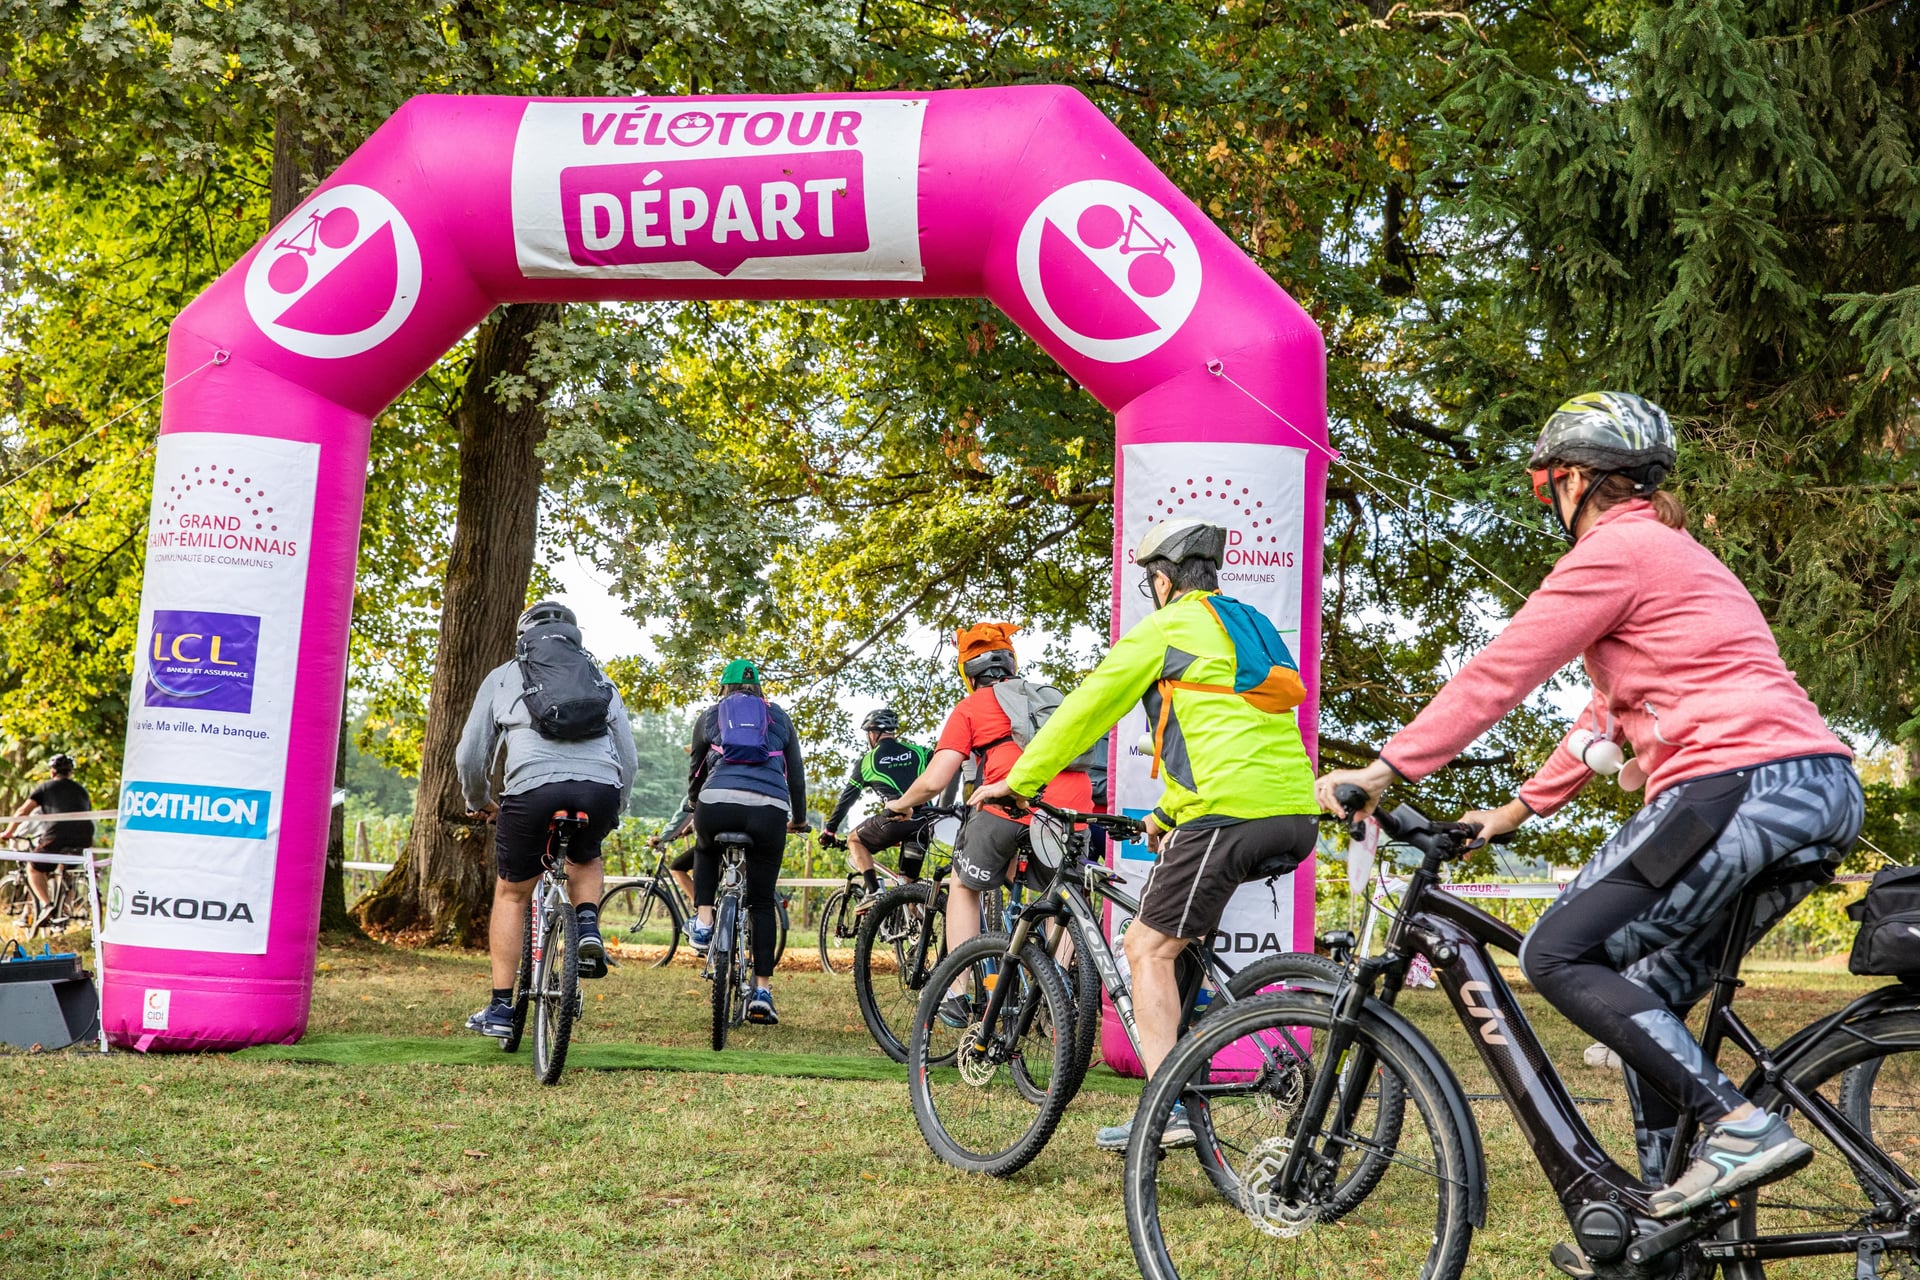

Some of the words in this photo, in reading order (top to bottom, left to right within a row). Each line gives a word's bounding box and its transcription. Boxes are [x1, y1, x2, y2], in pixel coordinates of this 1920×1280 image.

[581, 104, 862, 147] VÉLOTOUR
[579, 169, 847, 251] DÉPART
[179, 514, 241, 531] GRAND
[149, 530, 297, 557] SAINT-ÉMILIONNAIS
[204, 555, 215, 564] DE
[217, 556, 274, 569] COMMUNES
[1221, 572, 1276, 583] COMMUNES
[153, 633, 238, 665] LCL
[203, 669, 248, 678] ASSURANCE
[156, 721, 171, 731] Ma
[173, 721, 197, 733] ville.
[201, 723, 219, 735] Ma
[223, 725, 270, 739] banque.
[1129, 745, 1143, 756] M
[124, 790, 258, 825] DECATHLON
[130, 890, 254, 923] ŠKODA
[1214, 932, 1282, 953] ODA
